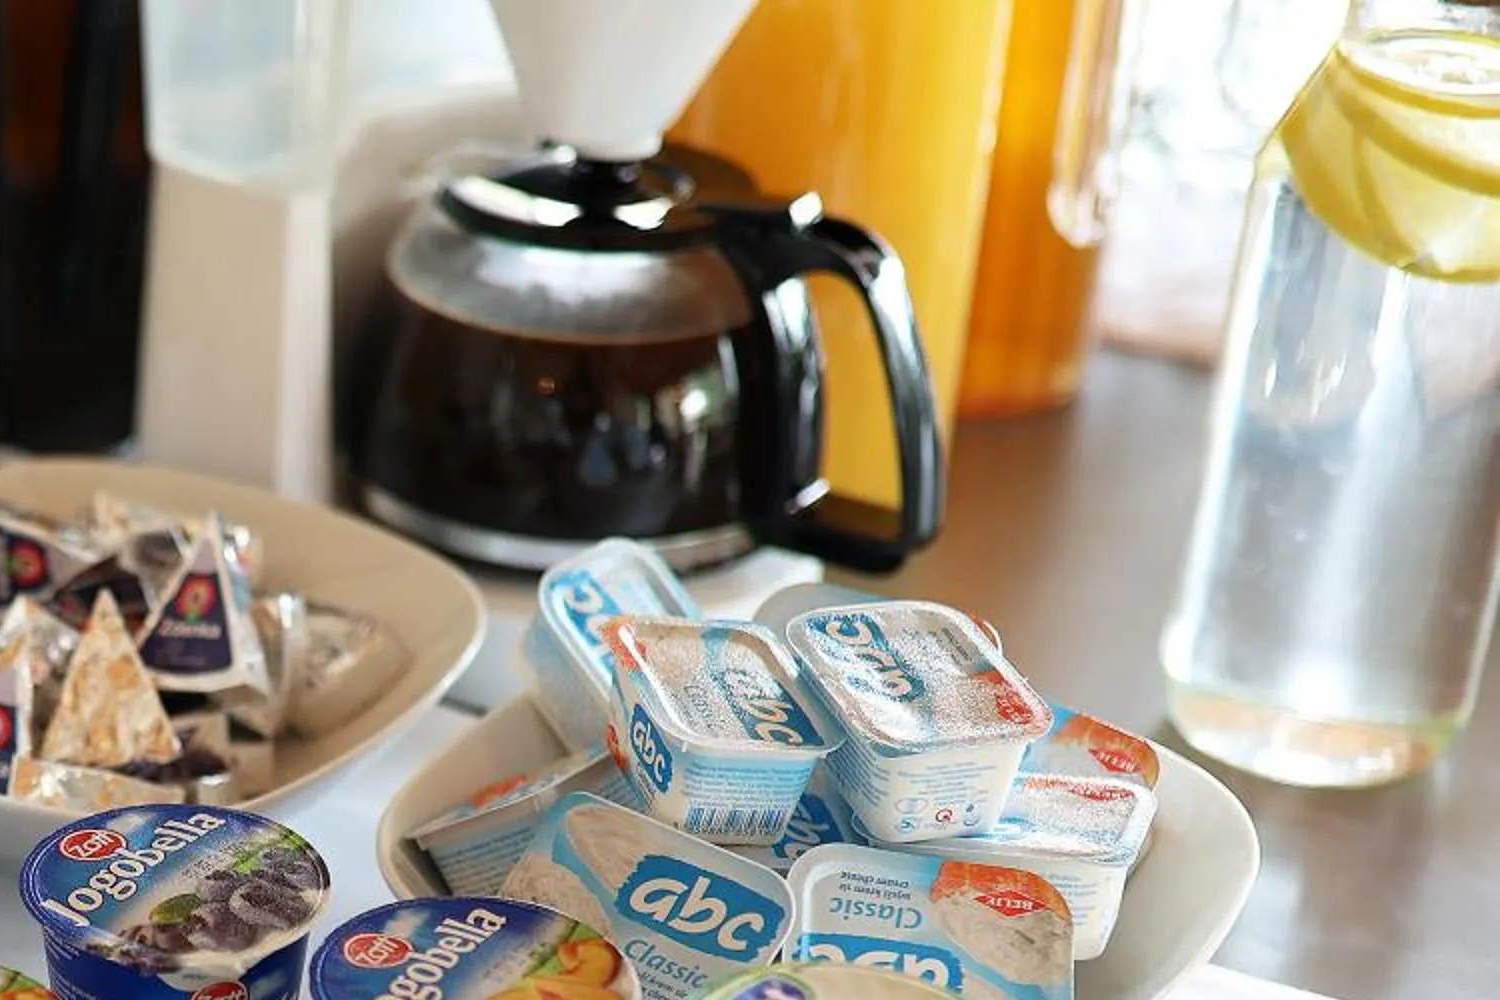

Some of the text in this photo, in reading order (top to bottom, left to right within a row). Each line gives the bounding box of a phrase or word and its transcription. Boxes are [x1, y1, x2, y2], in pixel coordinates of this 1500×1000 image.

[70, 829, 118, 858] Zott
[41, 811, 227, 928] Jogobella
[629, 875, 766, 952] abc
[829, 897, 923, 930] Classic
[624, 939, 709, 989] Classic
